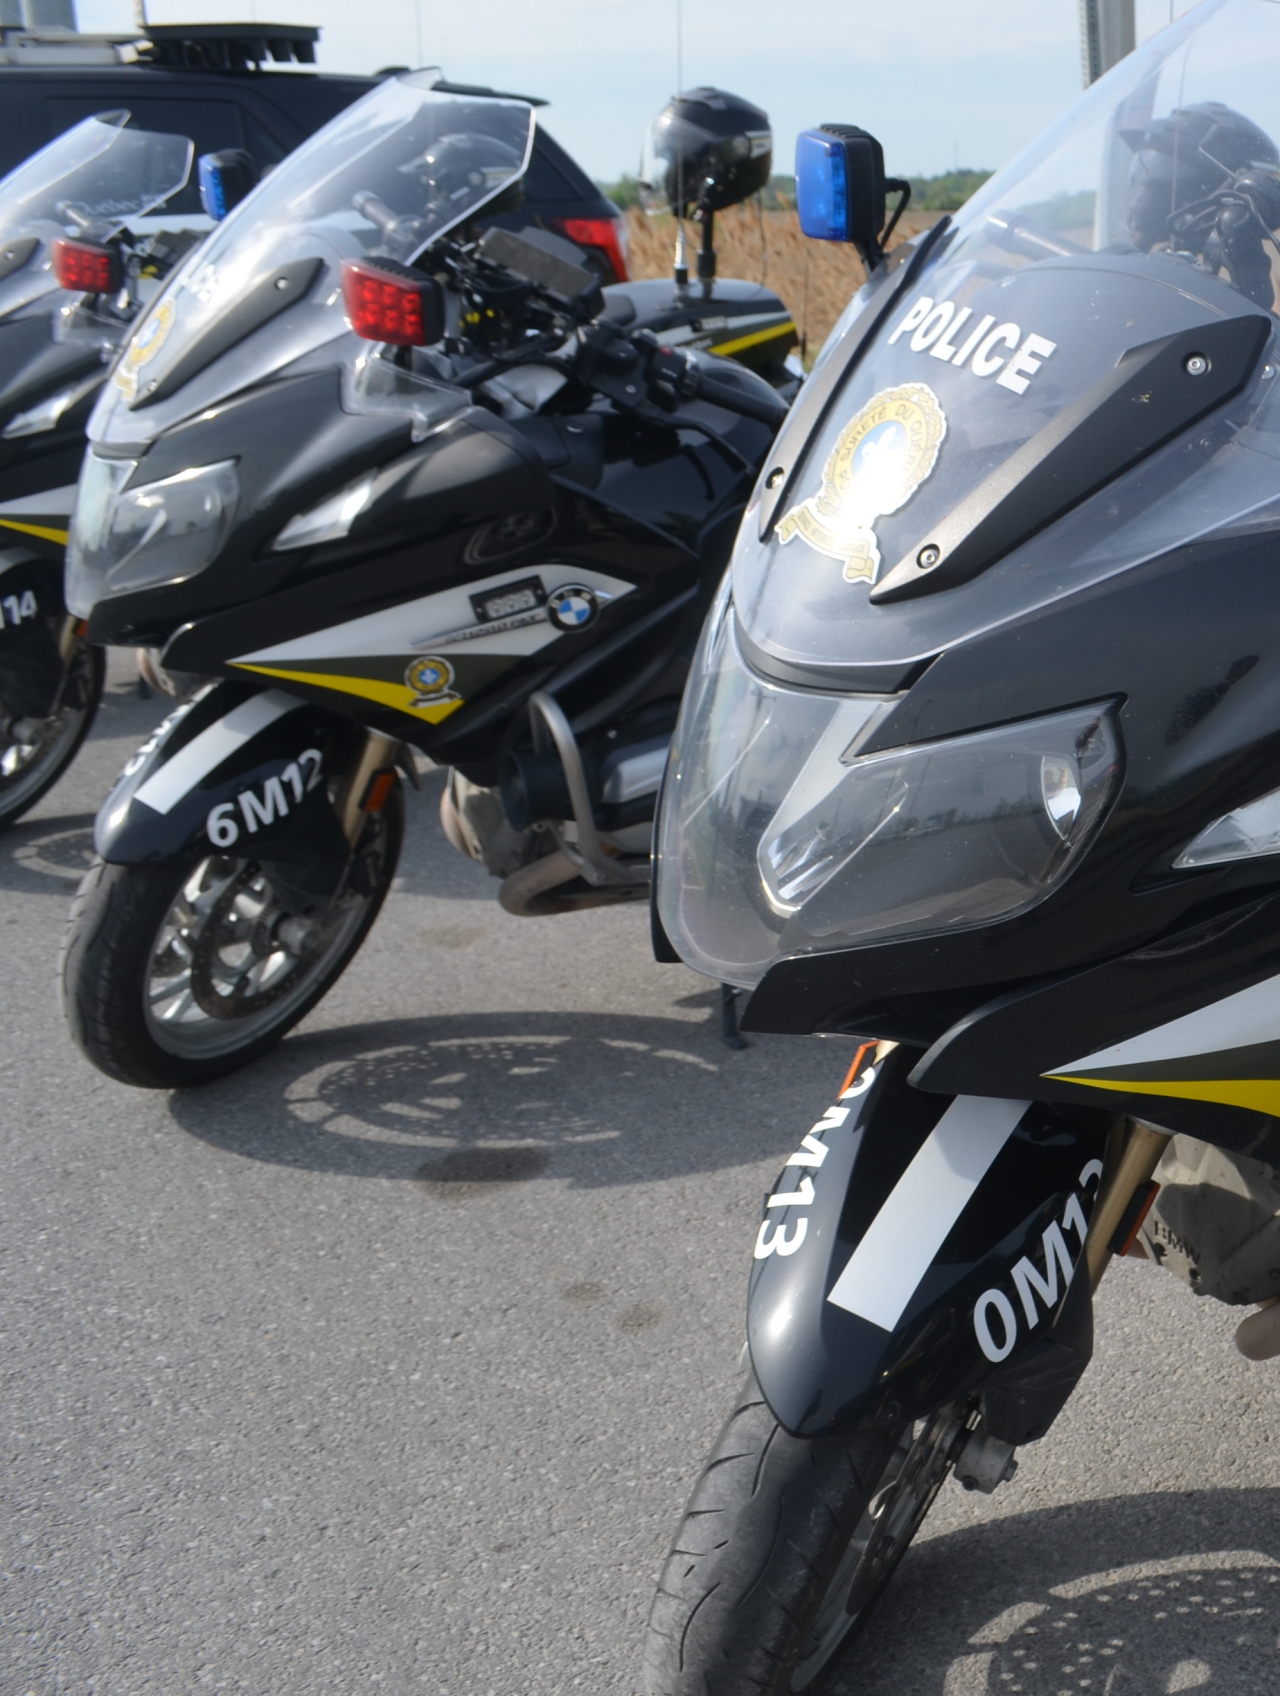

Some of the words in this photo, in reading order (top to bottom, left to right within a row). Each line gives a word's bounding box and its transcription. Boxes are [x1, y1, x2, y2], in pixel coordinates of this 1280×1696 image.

[887, 296, 1057, 395] POLICE
[894, 403, 915, 421] DU
[206, 748, 323, 848] 6M12
[1154, 1220, 1201, 1265] BMW
